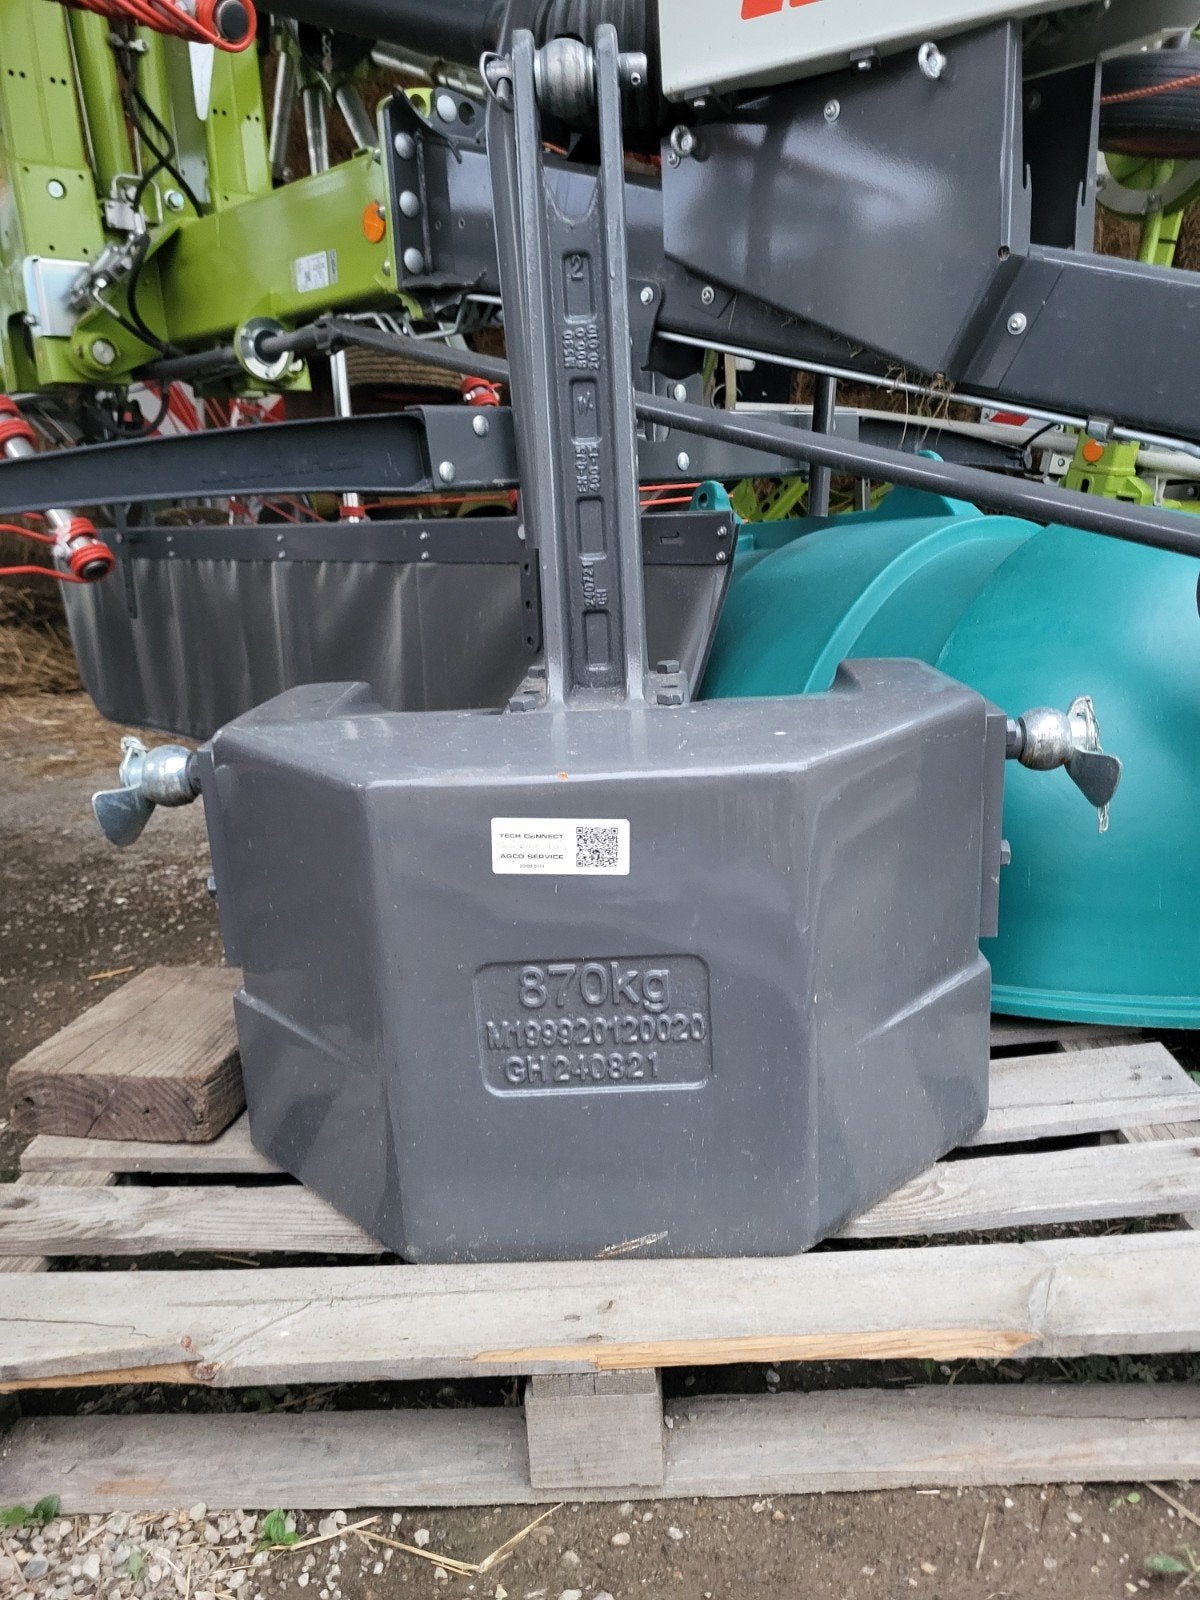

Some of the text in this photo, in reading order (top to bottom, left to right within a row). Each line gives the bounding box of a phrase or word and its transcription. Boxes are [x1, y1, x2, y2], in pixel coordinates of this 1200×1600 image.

[519, 961, 671, 1013] 870kg
[506, 1051, 659, 1084] GH 240821
